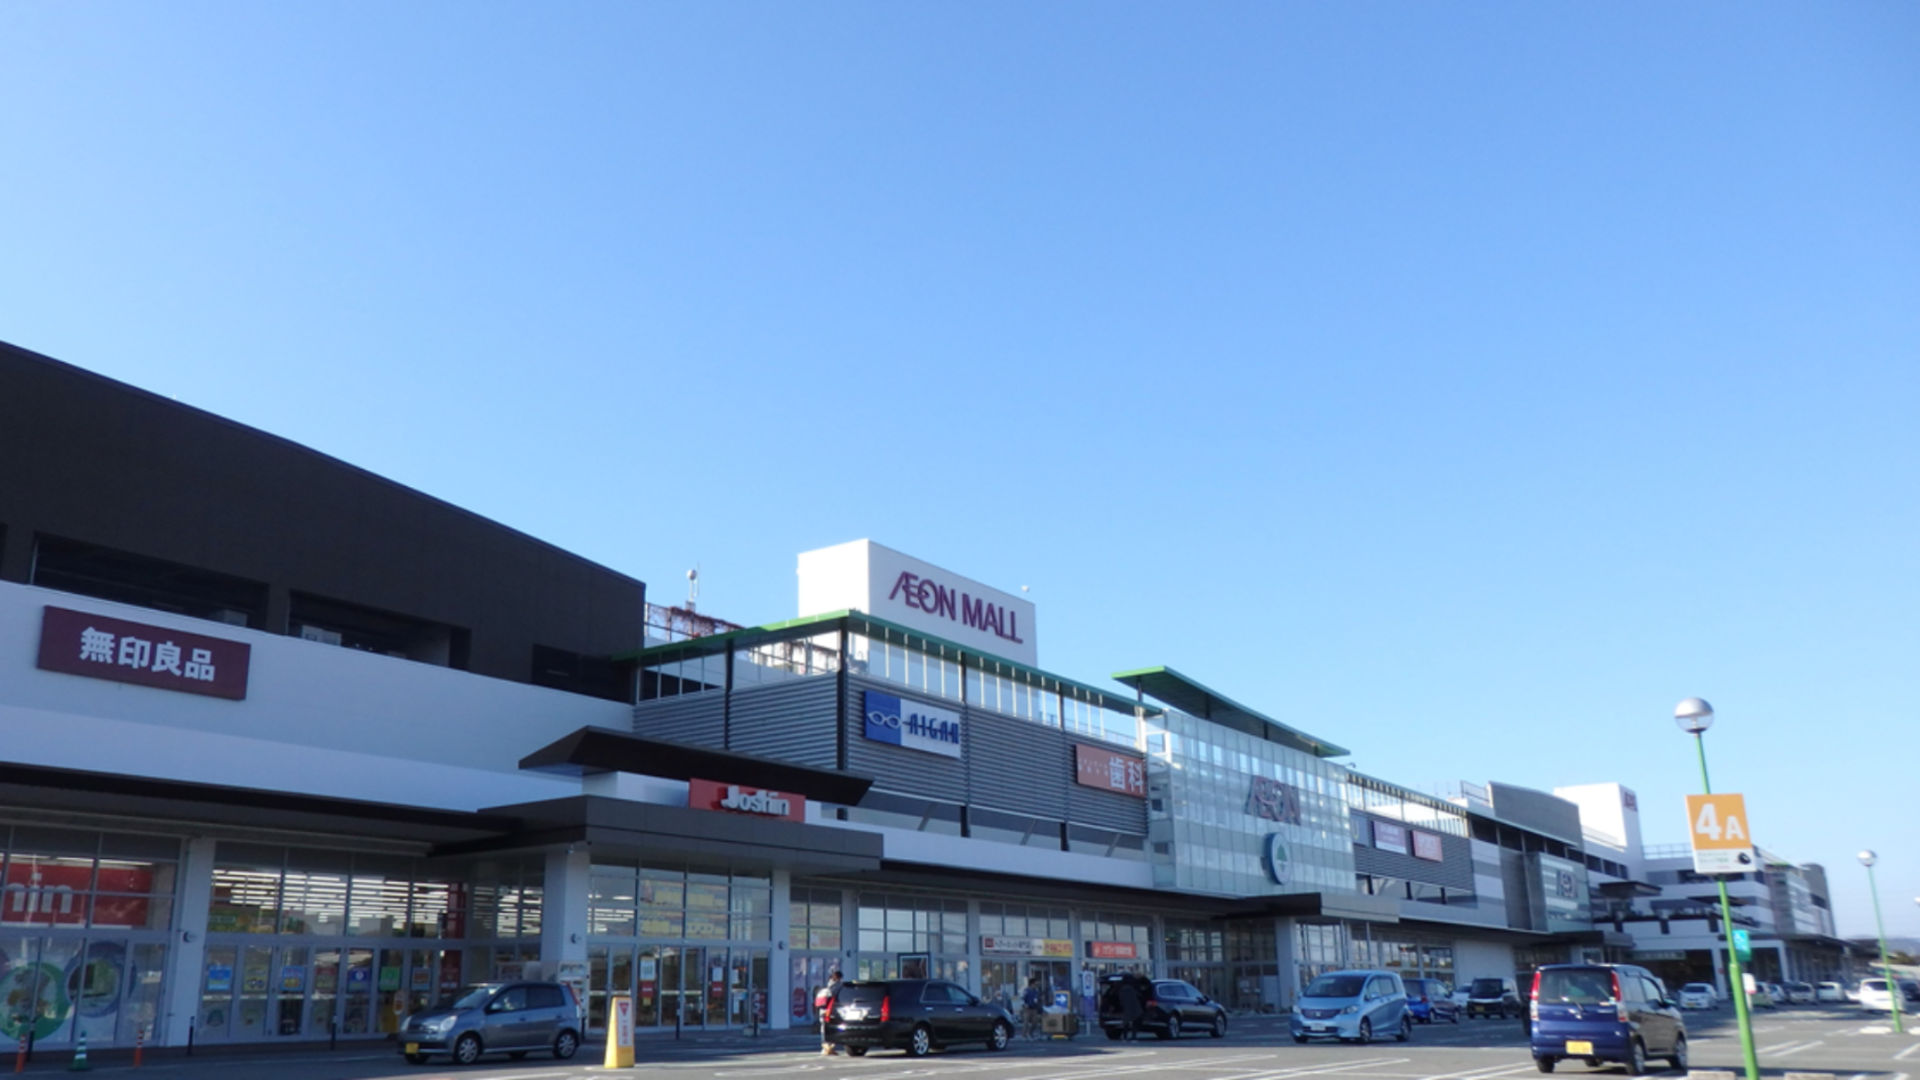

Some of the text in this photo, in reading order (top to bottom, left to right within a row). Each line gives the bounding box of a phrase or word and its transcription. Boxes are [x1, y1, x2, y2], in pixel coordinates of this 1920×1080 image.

[962, 593, 1023, 644] MALL
[79, 626, 215, 682] 無印良品
[908, 712, 960, 745] AIGAN
[1108, 756, 1144, 795] 歯科
[720, 785, 790, 816] Joshin
[1695, 803, 1745, 841] 4A
